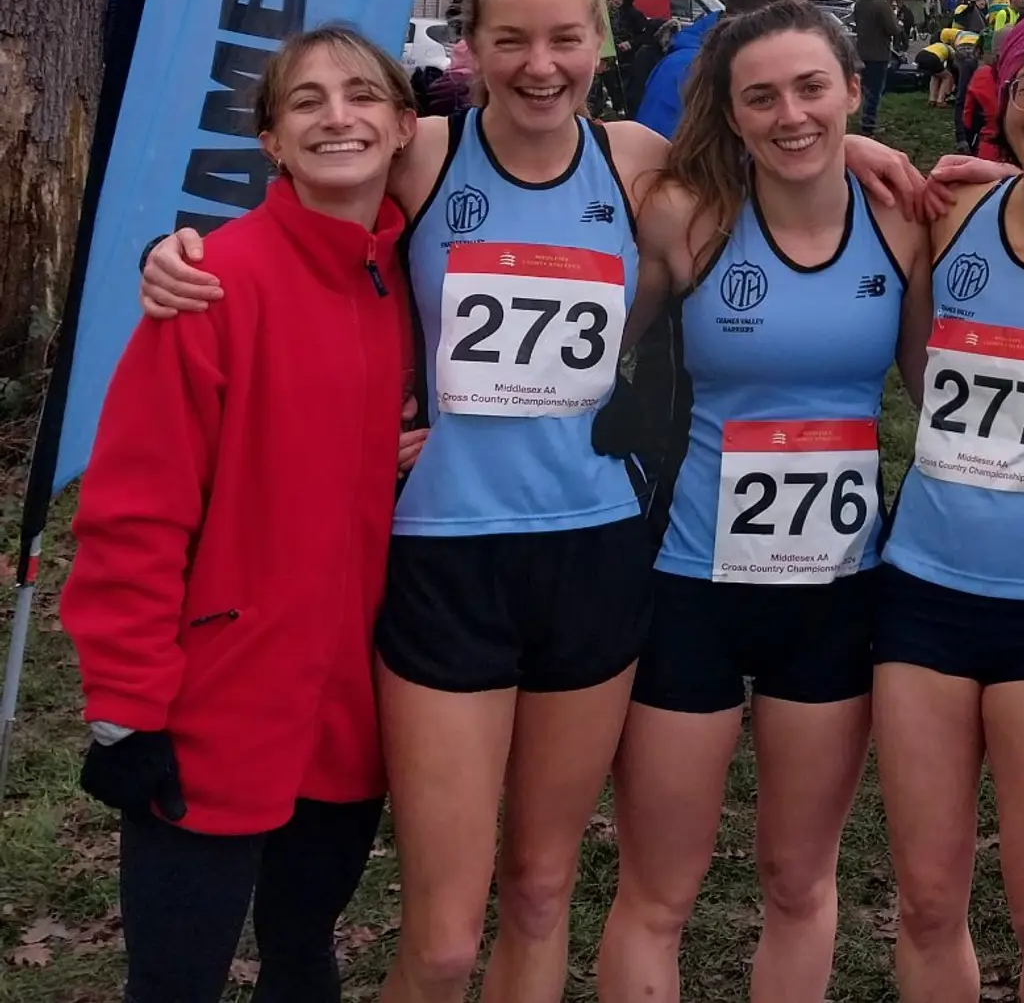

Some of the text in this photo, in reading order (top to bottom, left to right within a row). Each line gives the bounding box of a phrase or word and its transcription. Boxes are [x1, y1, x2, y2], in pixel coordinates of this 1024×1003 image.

[450, 294, 608, 369] 273
[494, 383, 557, 395] Middlesex AA
[442, 393, 468, 402] Cross
[471, 394, 509, 405] Country
[511, 396, 579, 407] Championships
[920, 456, 937, 467] Cross
[938, 459, 966, 474] Country
[957, 452, 1008, 469] Middlesex AA
[730, 470, 868, 536] 276
[770, 553, 829, 562] Middlesex AA
[721, 563, 748, 572] Cross
[749, 564, 784, 573] Country
